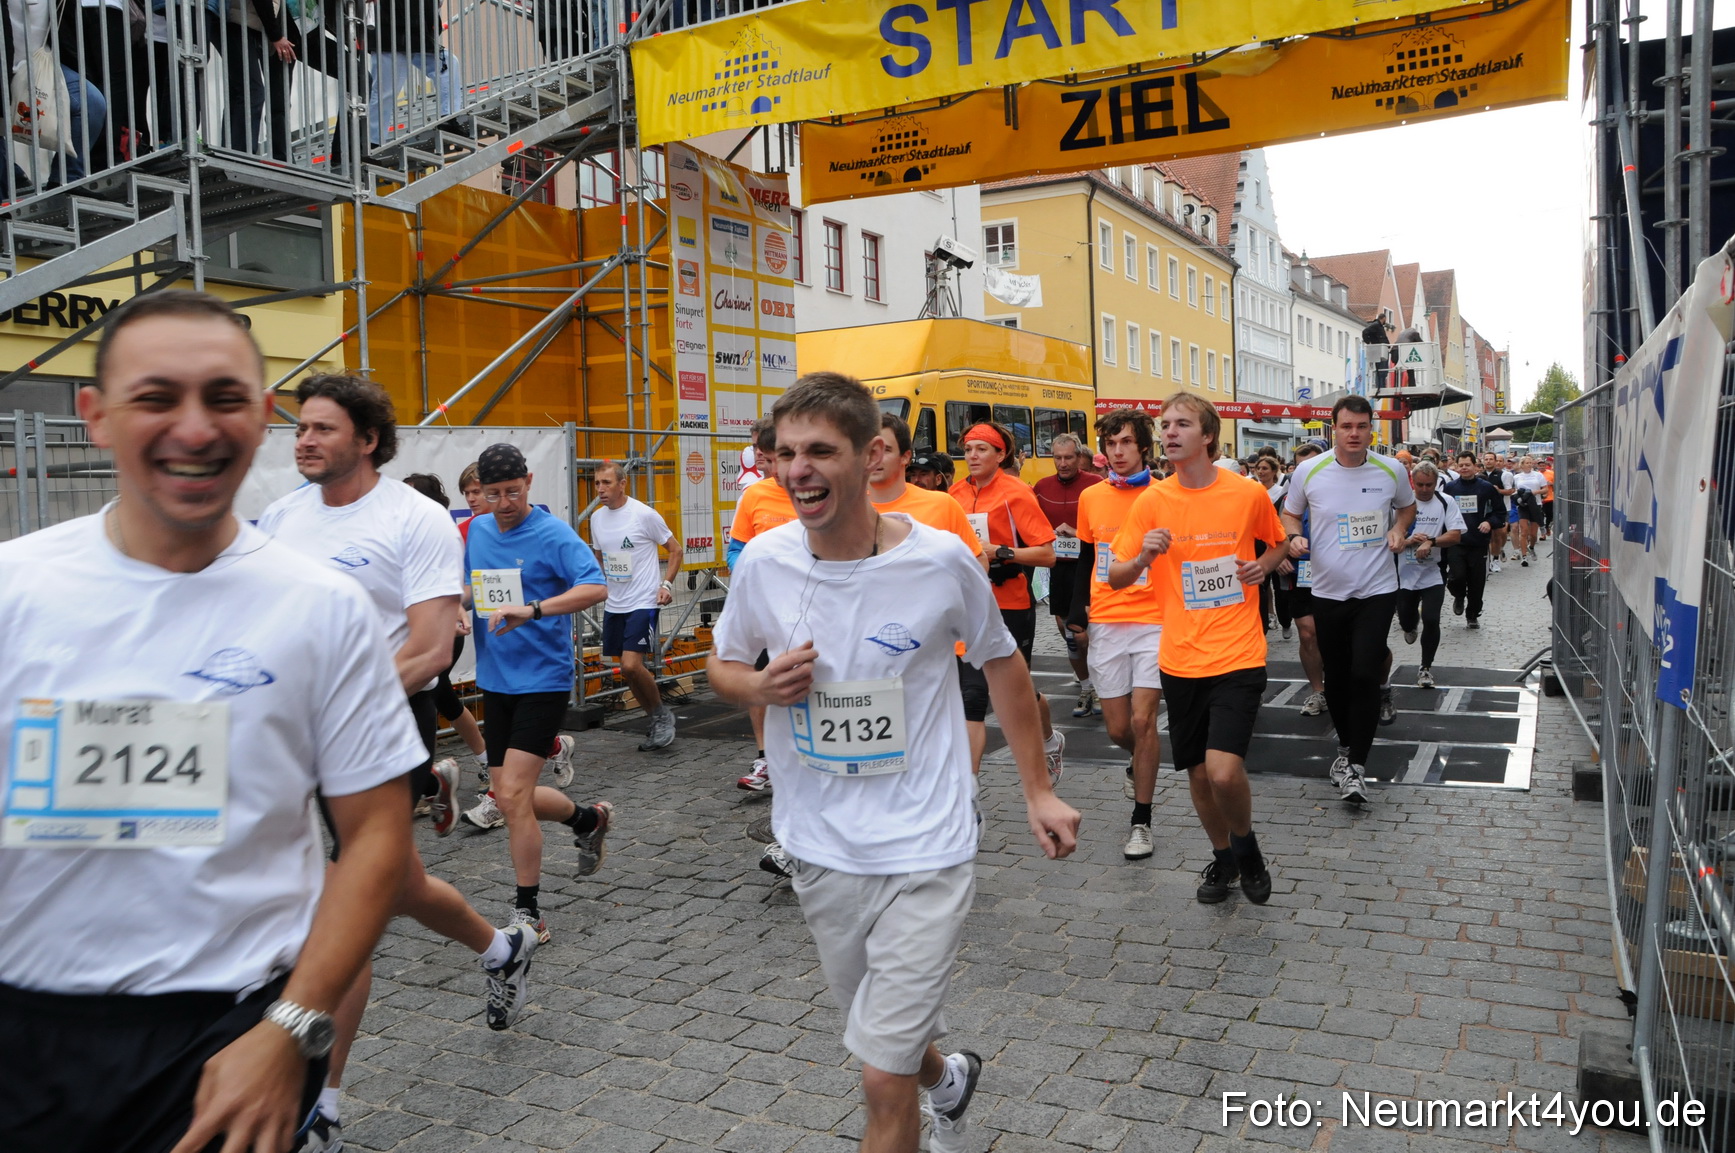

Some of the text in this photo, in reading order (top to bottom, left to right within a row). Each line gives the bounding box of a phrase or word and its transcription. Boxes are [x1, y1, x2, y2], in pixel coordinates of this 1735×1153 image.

[1332, 52, 1523, 100] Neumarkter Stadtlauf
[667, 63, 831, 106] Neumarkter Stadtlauf
[1060, 70, 1230, 151] ZIEL
[829, 141, 971, 173] Neumarkter Stadtlauf
[749, 187, 790, 207] MERZ
[680, 236, 695, 246] KANN
[764, 250, 788, 260] WITTMANN
[0, 291, 120, 329] ERRY
[675, 303, 704, 318] Sinupret
[760, 299, 795, 318] OBI
[676, 317, 693, 330] forte
[685, 341, 706, 351] Egner
[715, 352, 740, 366] swn
[762, 353, 786, 368] MCM
[967, 379, 997, 390] SPORTRONIC
[1042, 389, 1072, 401] EVENT SERVICE
[680, 421, 709, 430] HACKNER
[722, 478, 741, 491] forte
[1350, 515, 1375, 523] Christian
[1352, 524, 1378, 536] 3167
[687, 537, 712, 548] MERZ
[1057, 541, 1076, 549] 2962
[610, 564, 628, 572] 2885
[1194, 564, 1219, 575] Roland
[483, 575, 502, 584] Patrik
[1198, 574, 1233, 592] 2807
[489, 589, 512, 603] 631
[814, 691, 872, 708] Thomas
[75, 700, 154, 725] Murat
[820, 716, 893, 743] 2132
[74, 743, 204, 785] 2124
